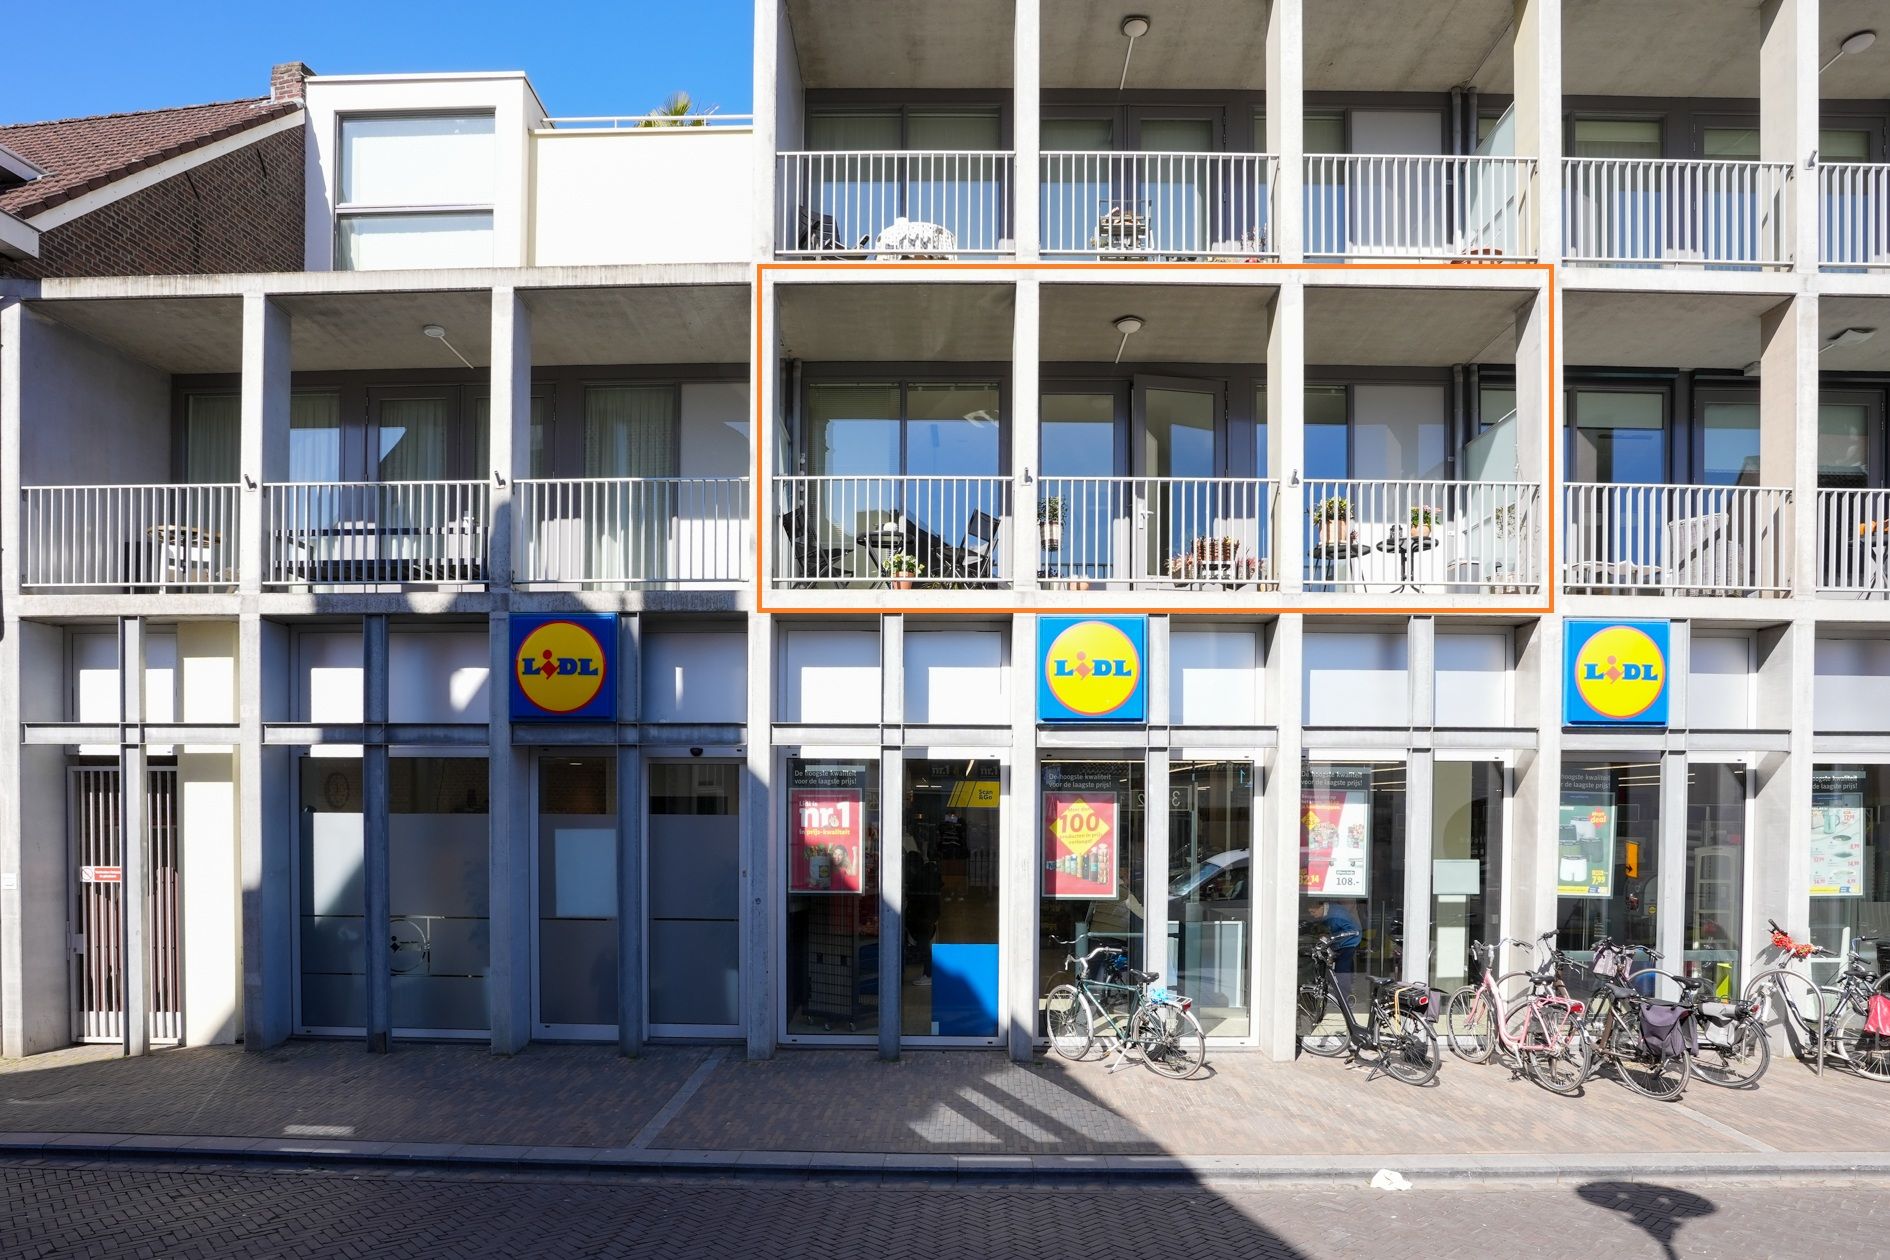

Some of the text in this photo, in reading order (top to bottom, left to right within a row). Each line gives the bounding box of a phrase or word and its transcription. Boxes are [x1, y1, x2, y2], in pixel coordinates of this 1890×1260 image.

[794, 769, 803, 777] De
[808, 777, 817, 785] de
[1063, 780, 1072, 788] de
[1072, 780, 1095, 789] laagste
[1060, 812, 1100, 833] 100
[1590, 815, 1607, 824] deal
